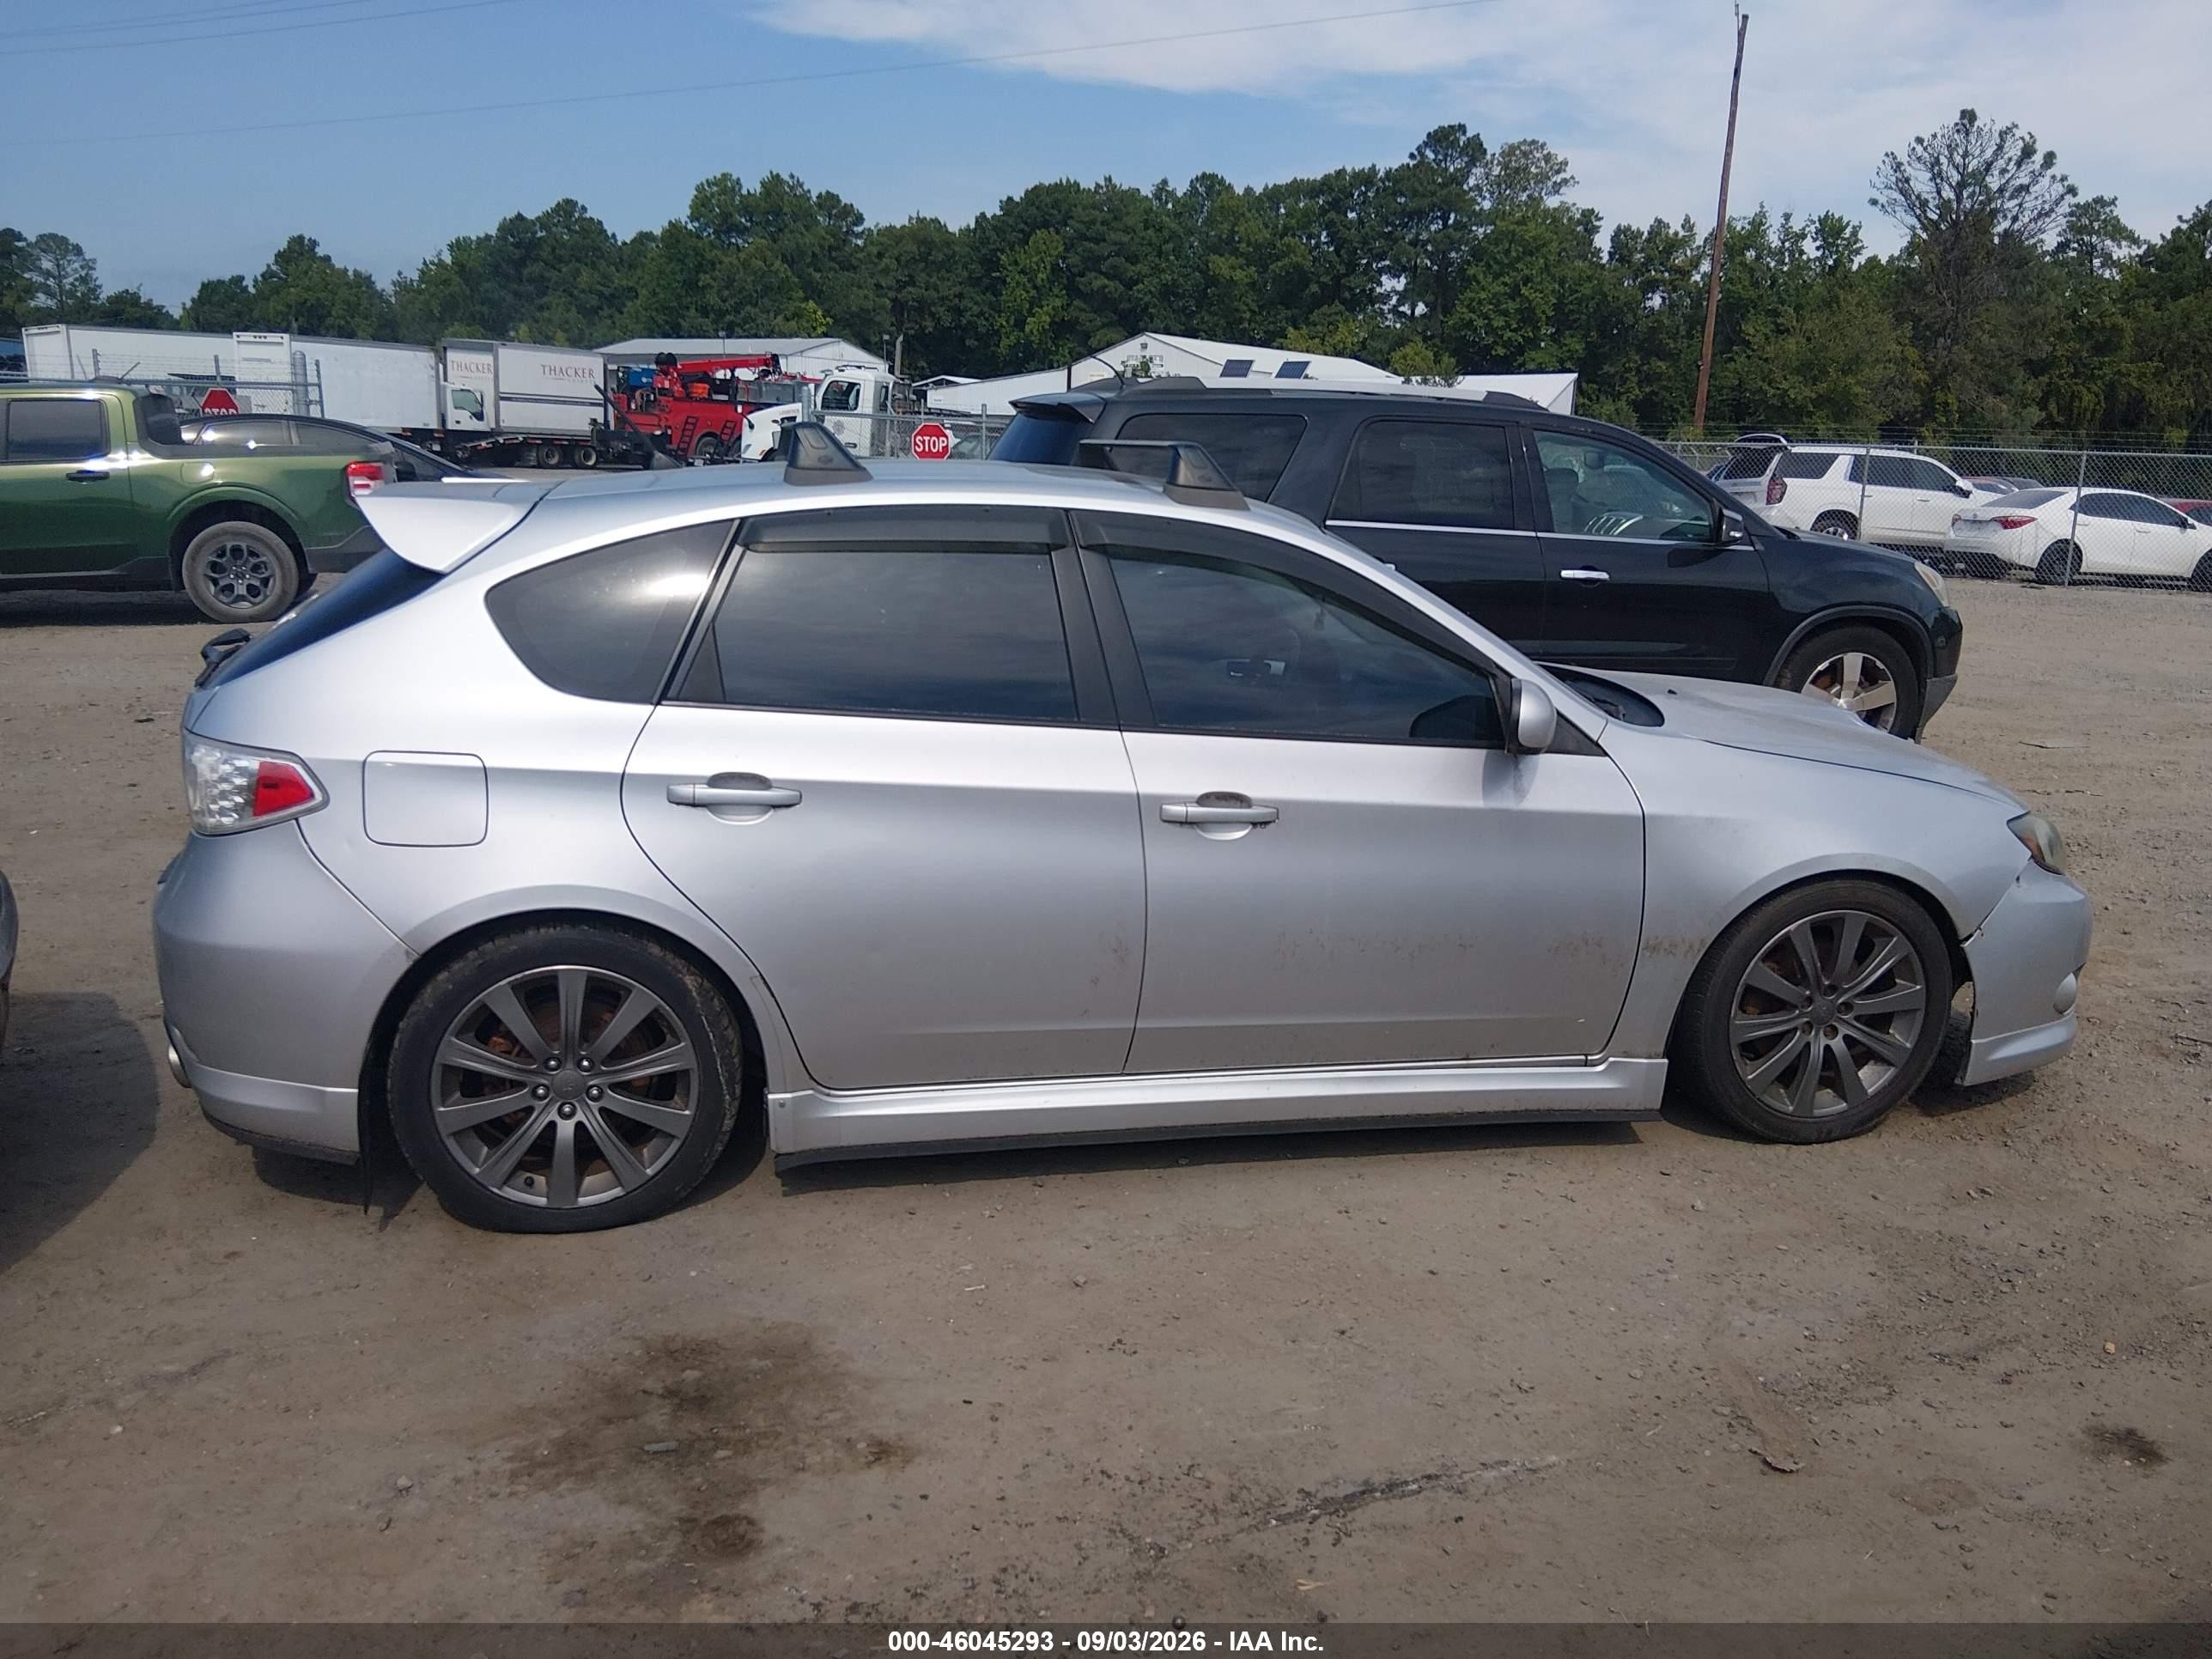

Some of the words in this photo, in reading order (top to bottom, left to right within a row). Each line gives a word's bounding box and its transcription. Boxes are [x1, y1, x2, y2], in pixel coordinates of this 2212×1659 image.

[451, 360, 493, 375] THACKER
[540, 364, 596, 379] THACKER
[915, 435, 948, 453] STOP
